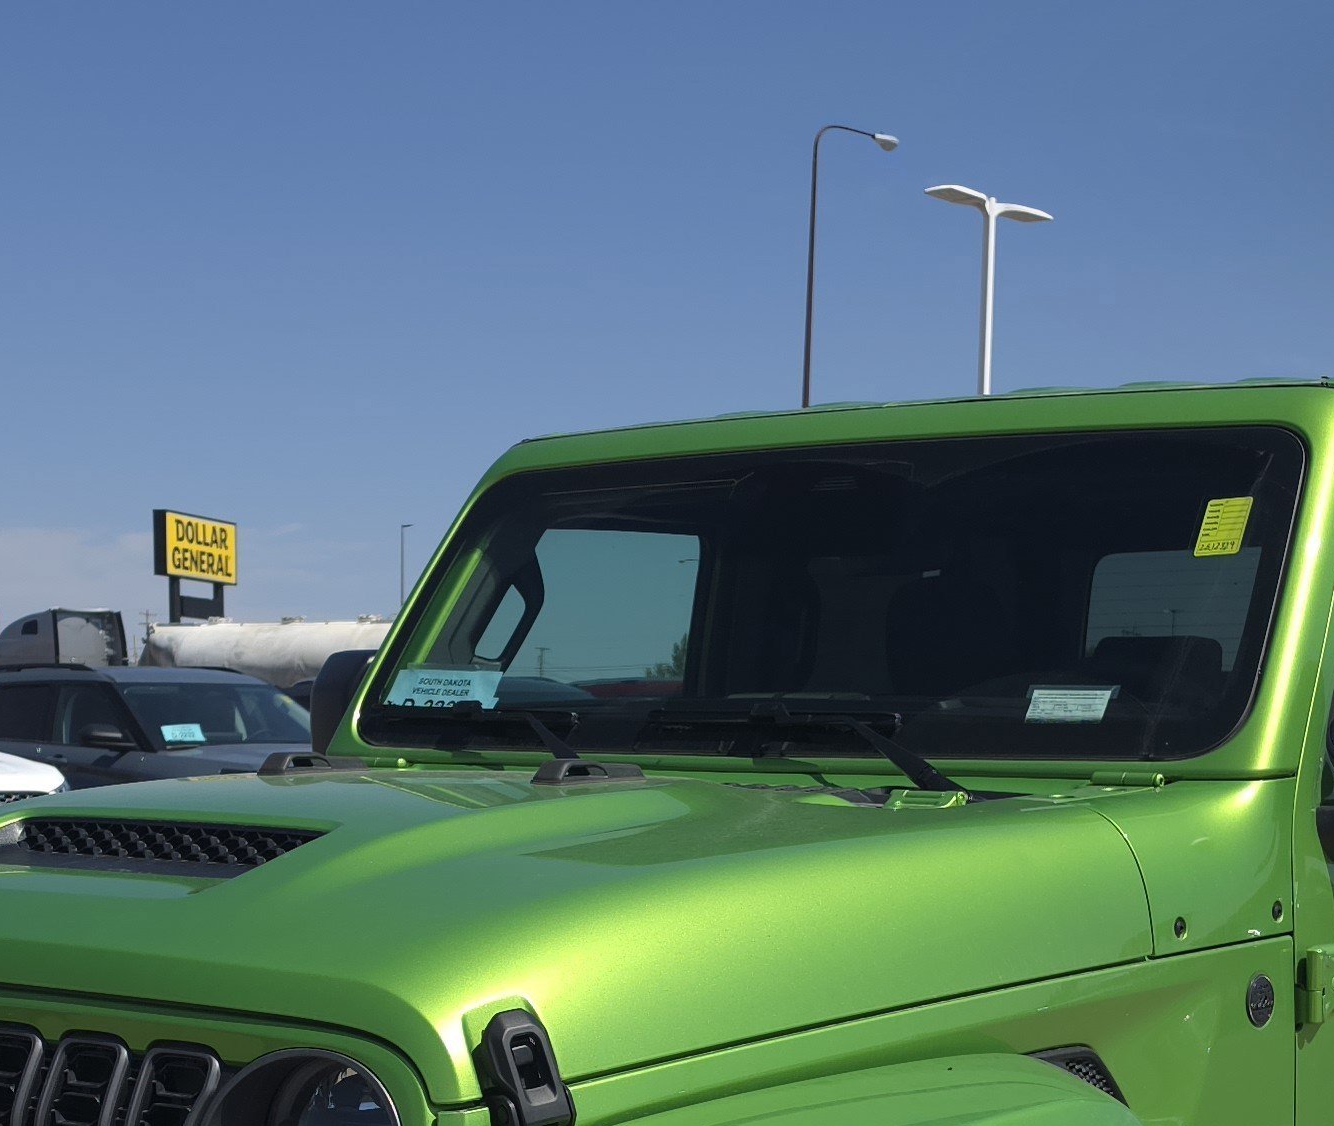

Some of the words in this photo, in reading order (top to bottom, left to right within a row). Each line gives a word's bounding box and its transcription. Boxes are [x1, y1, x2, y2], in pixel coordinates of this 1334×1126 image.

[175, 518, 228, 550] DOLLAR
[172, 546, 232, 577] GENERAL
[412, 687, 441, 696] VEHICLE
[442, 688, 470, 697] DEALER
[418, 678, 442, 686] SOUTH
[443, 678, 471, 687] DAKOTA
